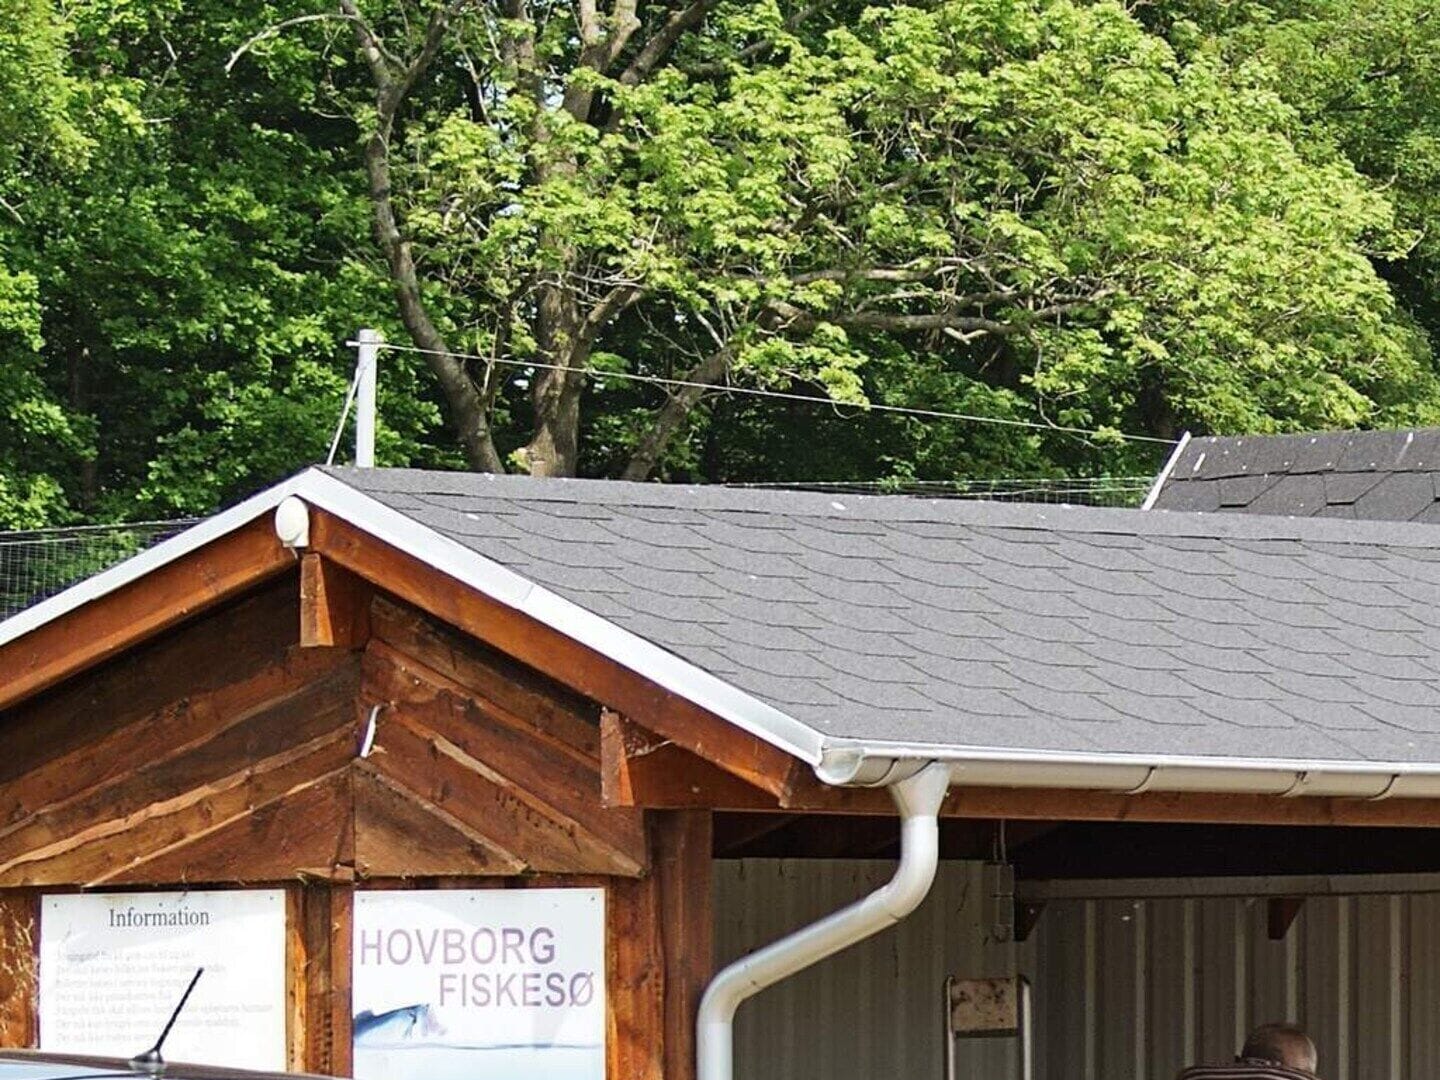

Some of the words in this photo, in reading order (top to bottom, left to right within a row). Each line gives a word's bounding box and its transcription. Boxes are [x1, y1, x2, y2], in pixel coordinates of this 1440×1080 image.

[109, 906, 210, 928] Information
[360, 926, 555, 966] HOVBORG
[440, 971, 594, 1008] FISKESØ
